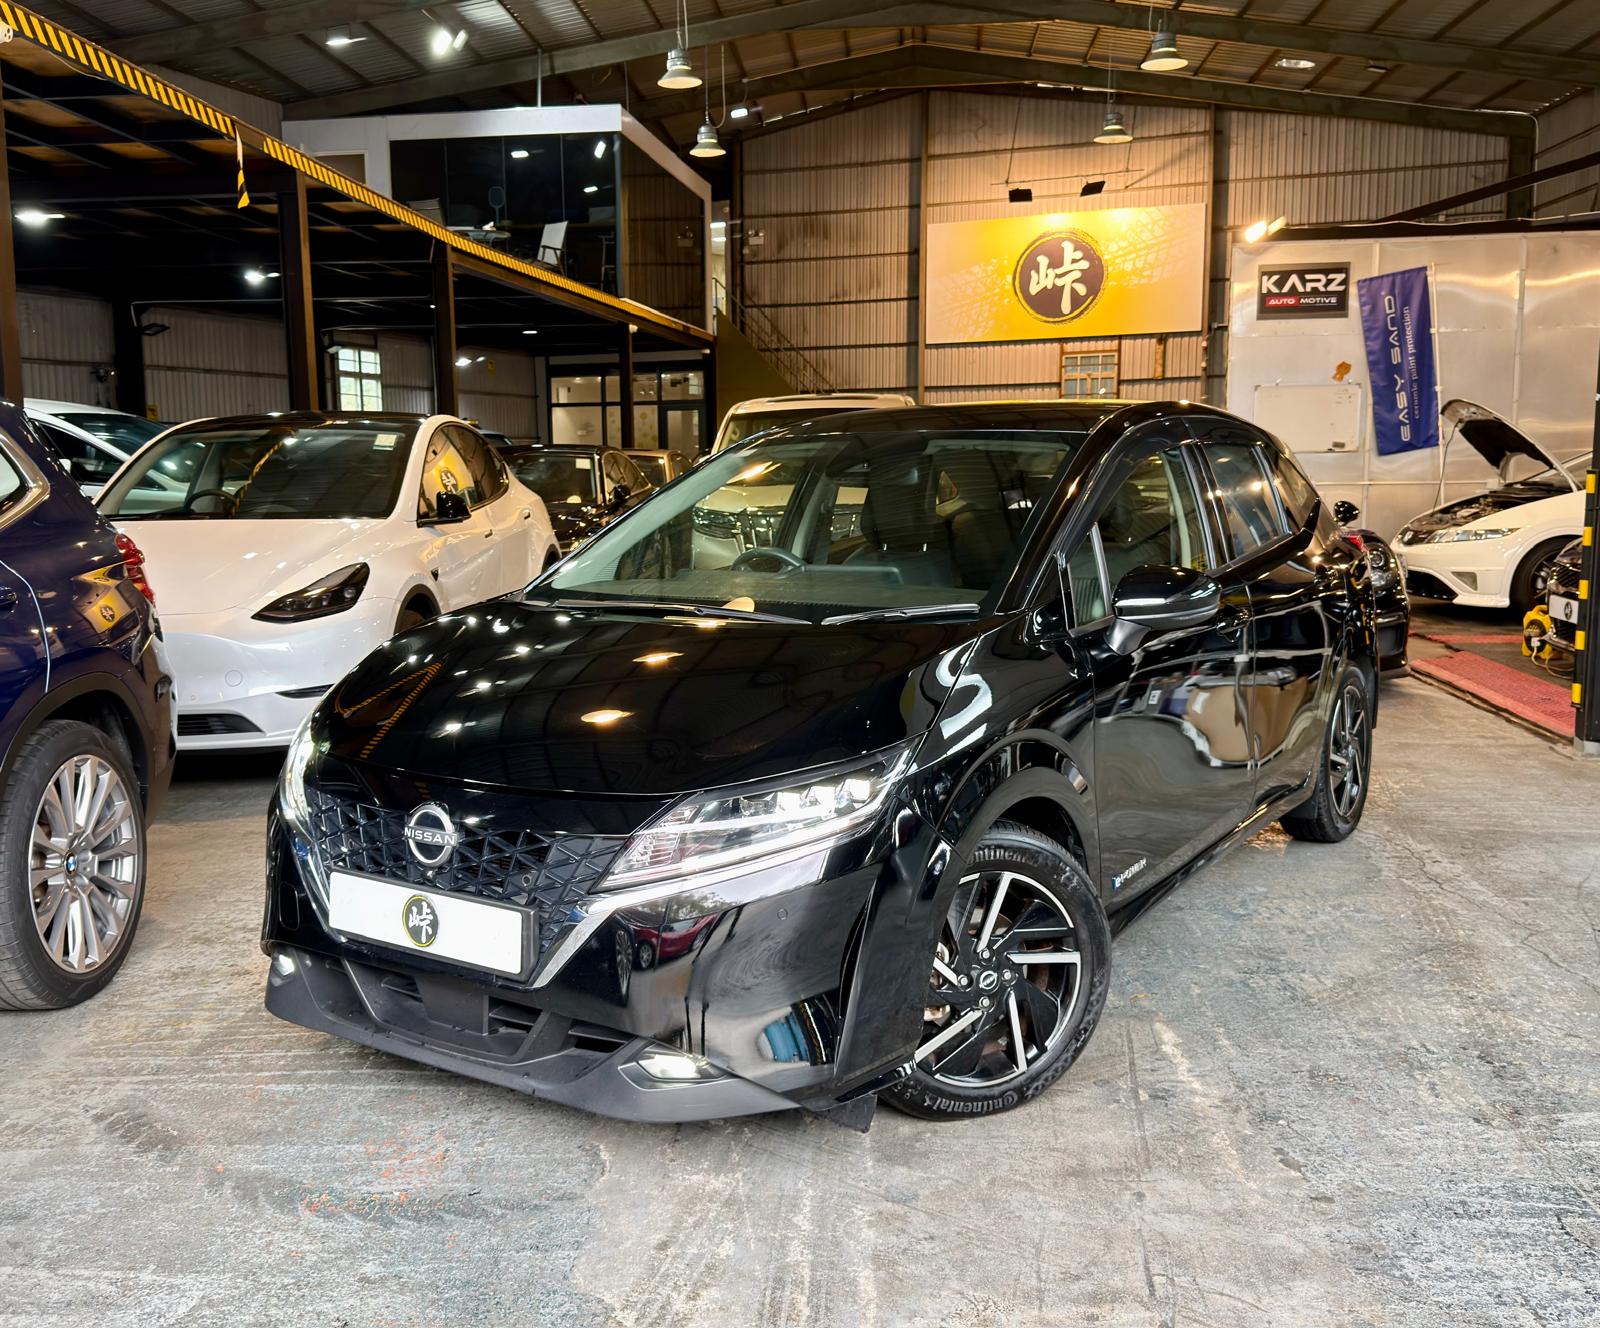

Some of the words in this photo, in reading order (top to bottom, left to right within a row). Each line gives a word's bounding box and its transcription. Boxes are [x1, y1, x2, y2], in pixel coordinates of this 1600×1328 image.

[1028, 240, 1091, 315] 峠
[1261, 273, 1346, 293] KARZ
[1268, 297, 1296, 305] AUTO
[1299, 296, 1337, 304] MOTIVE
[1384, 295, 1402, 364] SAND
[1403, 306, 1416, 354] protection
[1407, 355, 1419, 380] paint
[1393, 374, 1411, 442] EASY
[404, 827, 457, 846] NISSAN
[408, 902, 434, 944] 峠
[932, 1090, 1019, 1114] Continental
